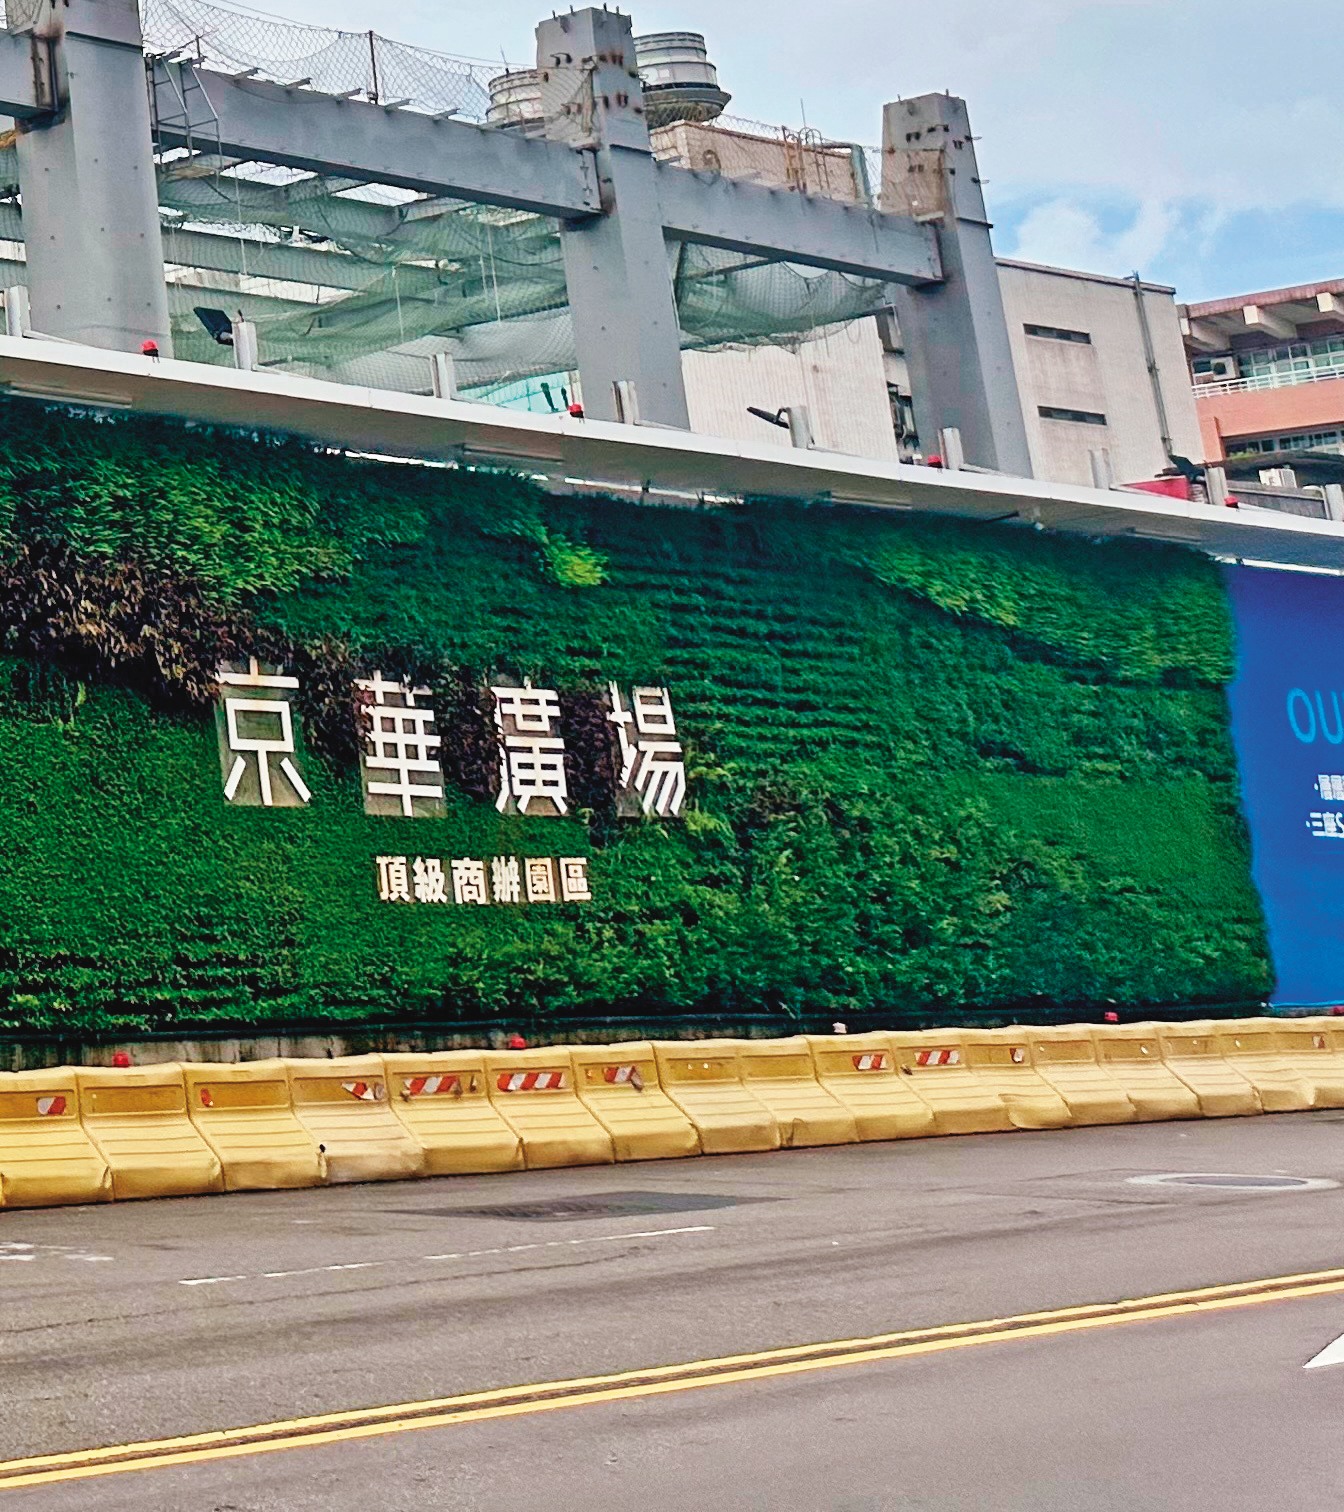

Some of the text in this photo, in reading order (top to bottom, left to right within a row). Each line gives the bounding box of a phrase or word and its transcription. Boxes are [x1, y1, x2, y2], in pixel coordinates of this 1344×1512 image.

[216, 656, 685, 817] 京華廣場
[1286, 687, 1344, 745] OU
[375, 855, 592, 905] 頂級商辦園區
